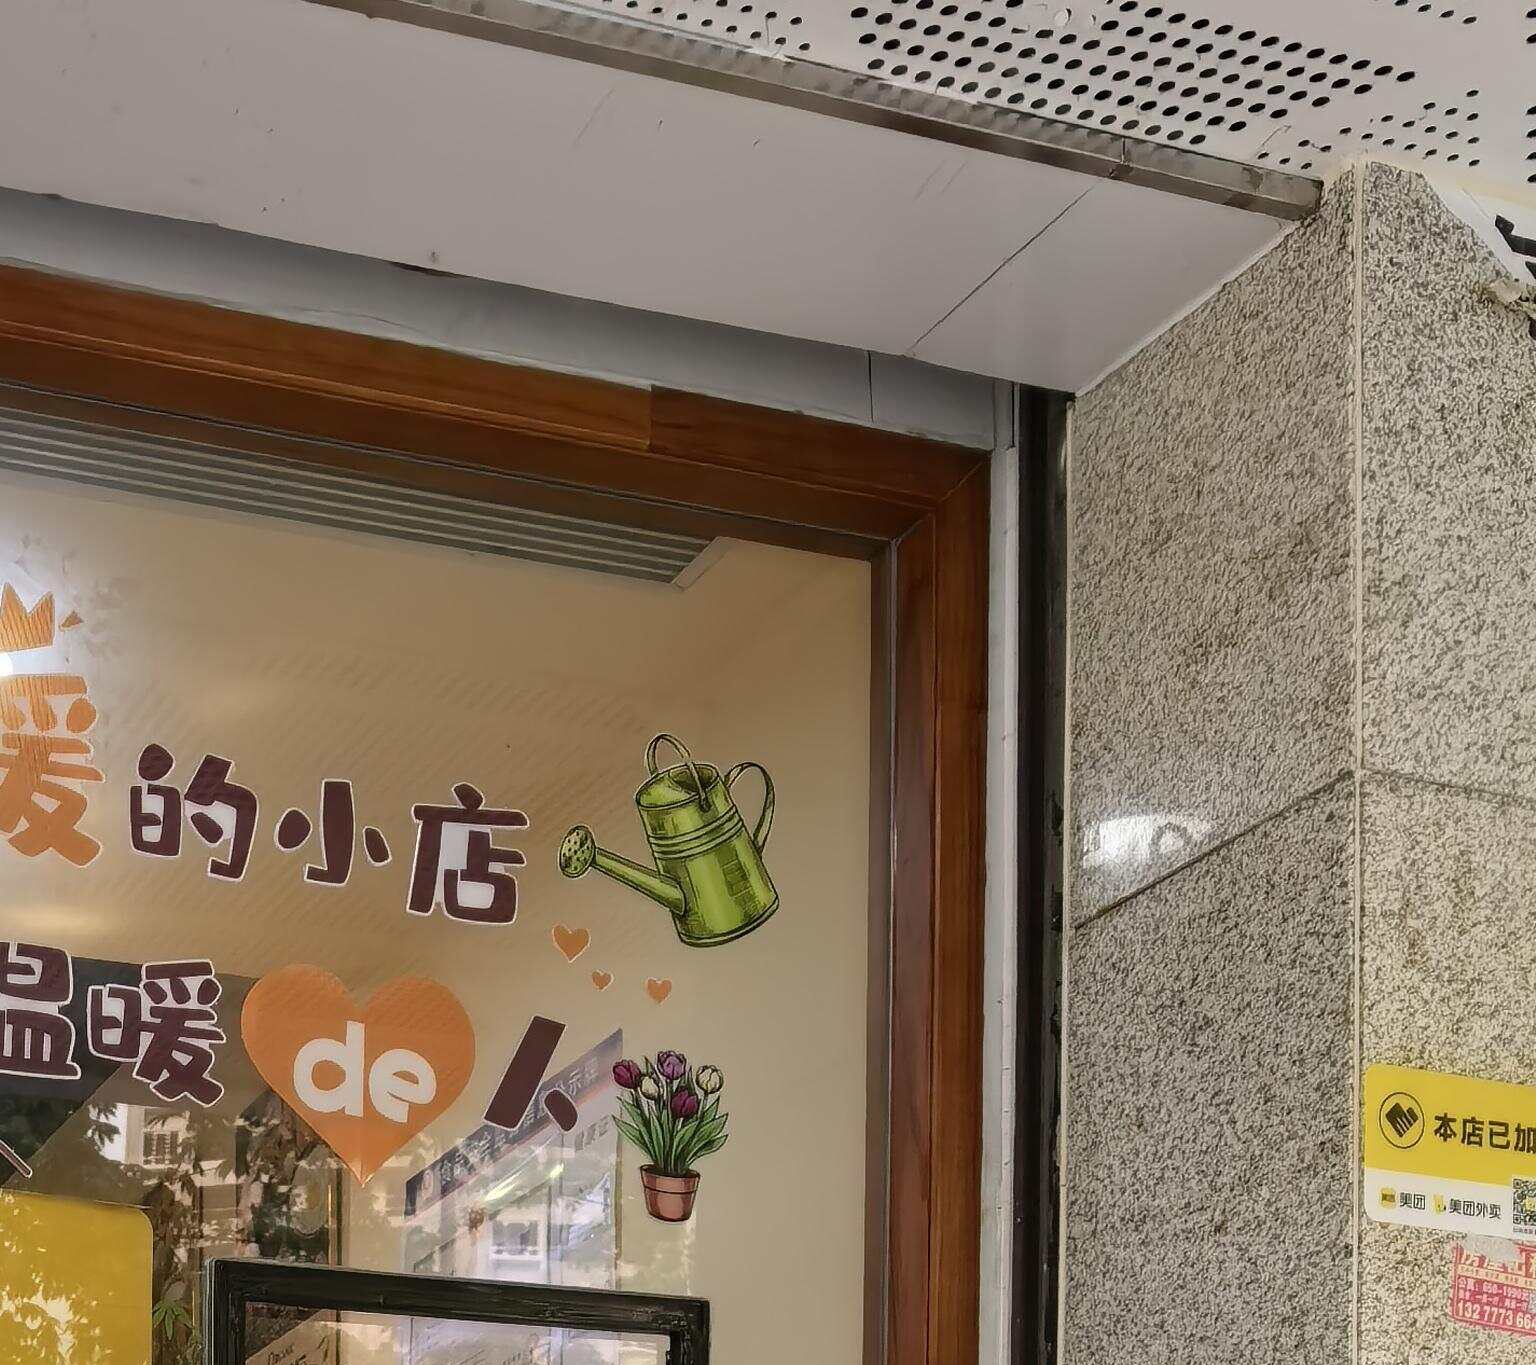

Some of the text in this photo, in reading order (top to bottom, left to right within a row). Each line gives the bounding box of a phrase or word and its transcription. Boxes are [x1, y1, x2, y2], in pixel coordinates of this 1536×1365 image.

[292, 1020, 438, 1124] de
[1399, 1192, 1502, 1219] 美团 美团外卖
